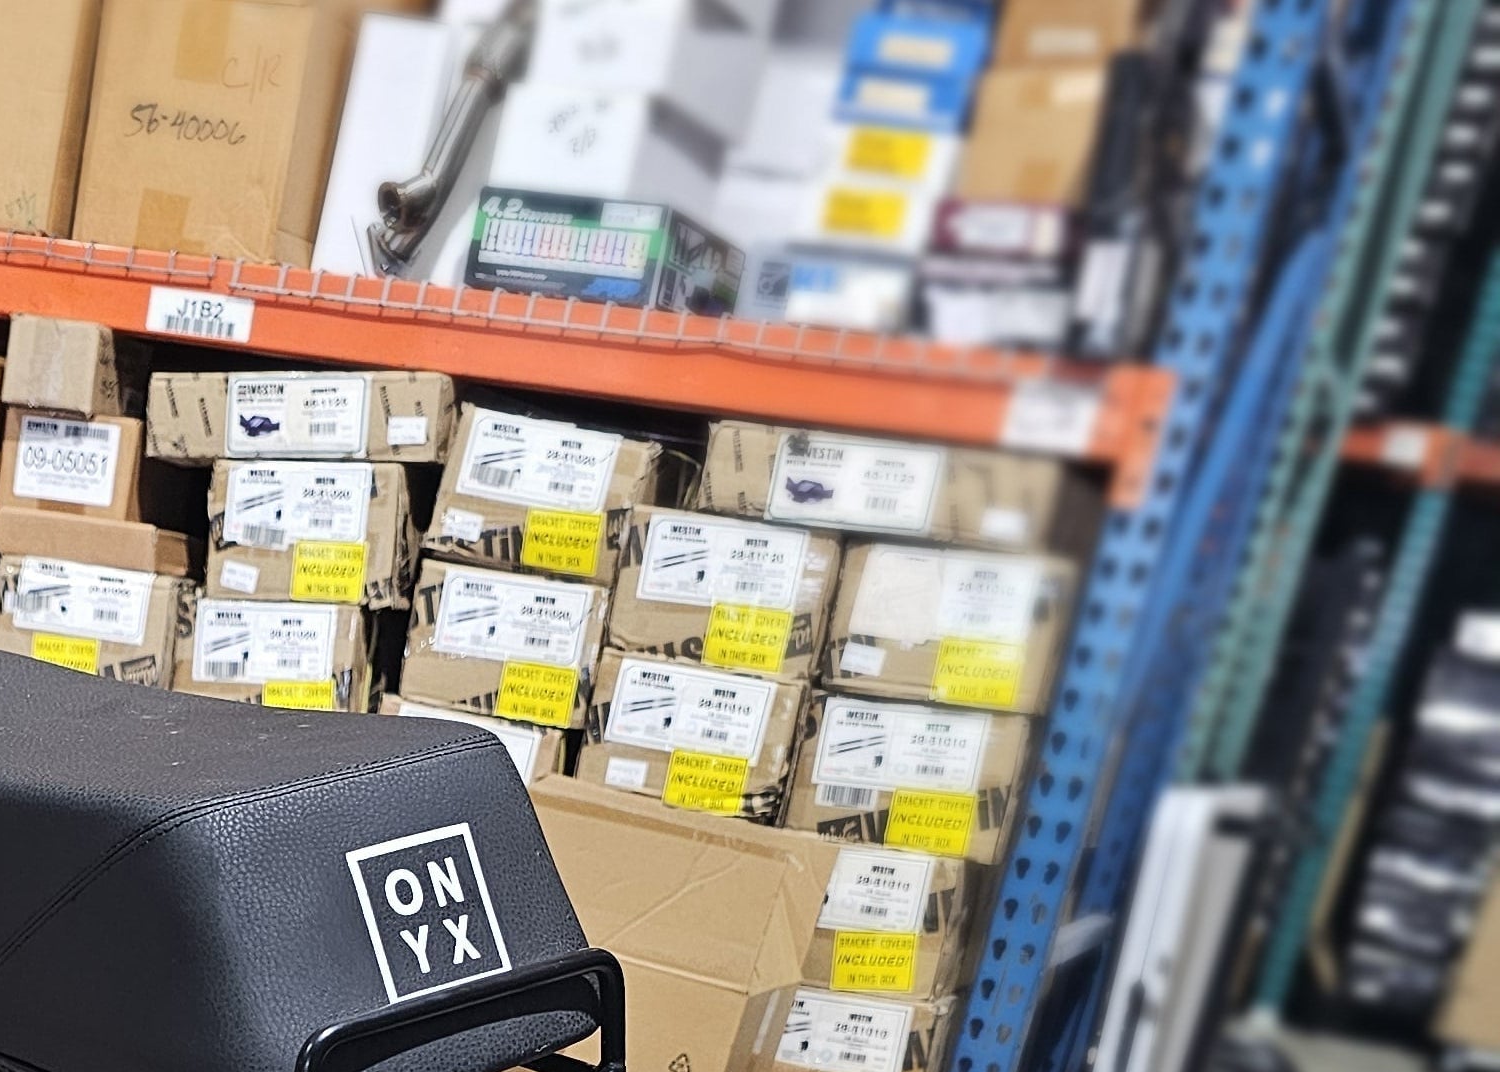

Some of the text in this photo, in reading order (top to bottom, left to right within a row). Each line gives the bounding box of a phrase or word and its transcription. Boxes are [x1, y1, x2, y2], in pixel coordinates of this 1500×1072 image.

[124, 103, 246, 145] 56-40006
[482, 196, 524, 219] 4.2
[177, 299, 224, 319] J1B2
[674, 755, 744, 775] BRACKET COVERS
[672, 773, 739, 793] INCLUDED!
[897, 795, 971, 812] BRACKET COVERS
[893, 814, 967, 832] INCLUDED!
[839, 936, 913, 950] BRACKET COVERS
[837, 954, 910, 968] INCLUDED!
